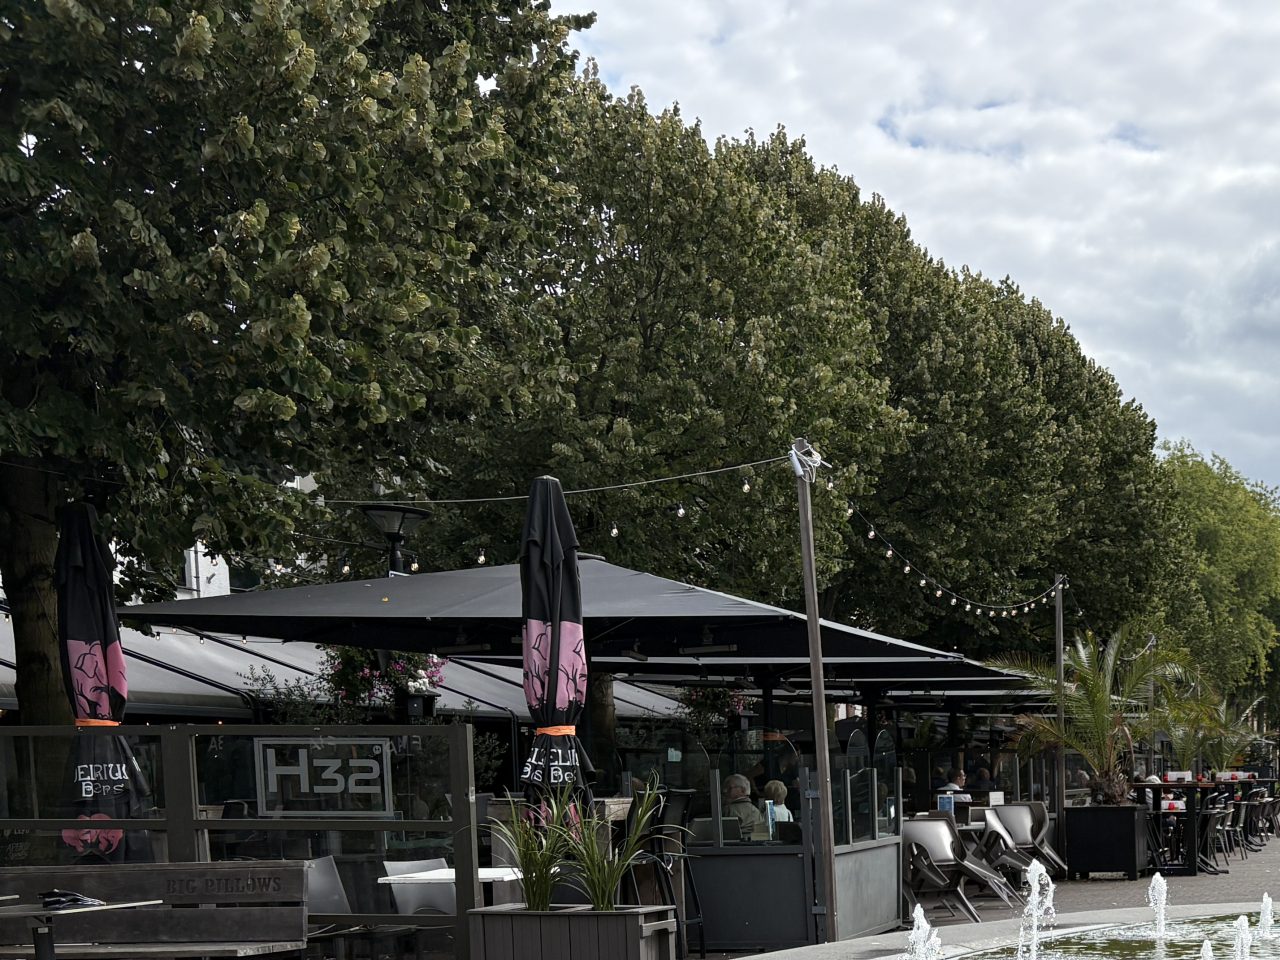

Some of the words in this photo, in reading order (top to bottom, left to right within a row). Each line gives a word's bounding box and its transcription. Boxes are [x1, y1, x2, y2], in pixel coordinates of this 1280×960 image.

[266, 748, 382, 794] H32
[166, 879, 198, 895] BIG
[204, 877, 282, 894] PILLOWS
